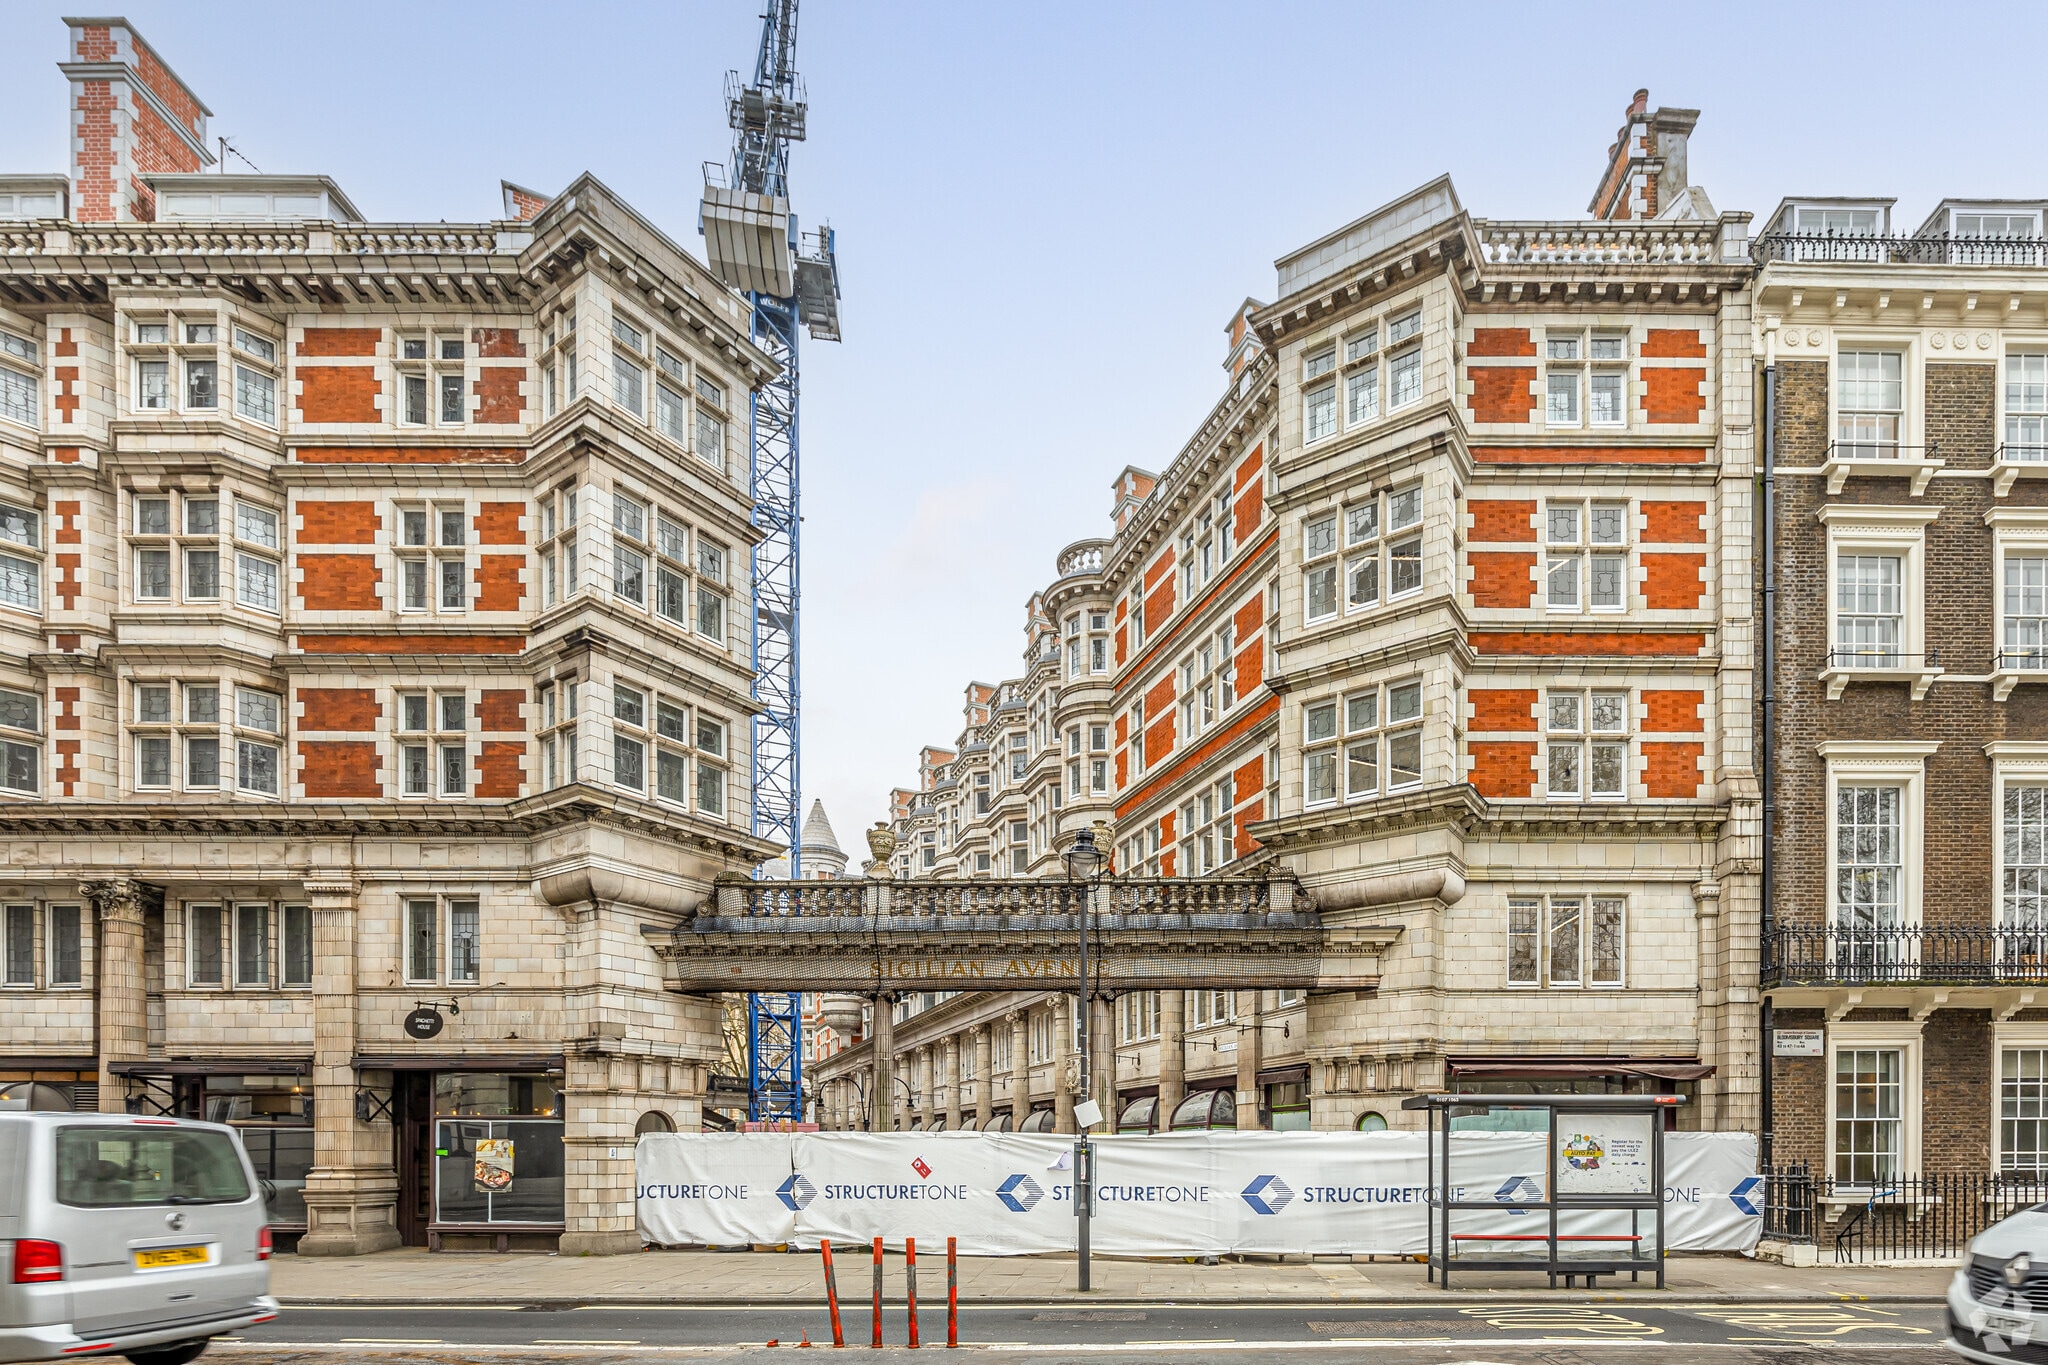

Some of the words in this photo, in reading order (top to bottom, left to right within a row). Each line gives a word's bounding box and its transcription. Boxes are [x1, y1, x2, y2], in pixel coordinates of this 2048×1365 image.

[760, 297, 790, 313] WOLFF
[870, 959, 985, 977] SICILIAN
[1004, 959, 1110, 977] AVENUE
[825, 1184, 967, 1200] STRUCTURETONE
[1052, 1185, 1209, 1202] STCTURETONE
[1303, 1186, 1465, 1203] STRUCTURETONE
